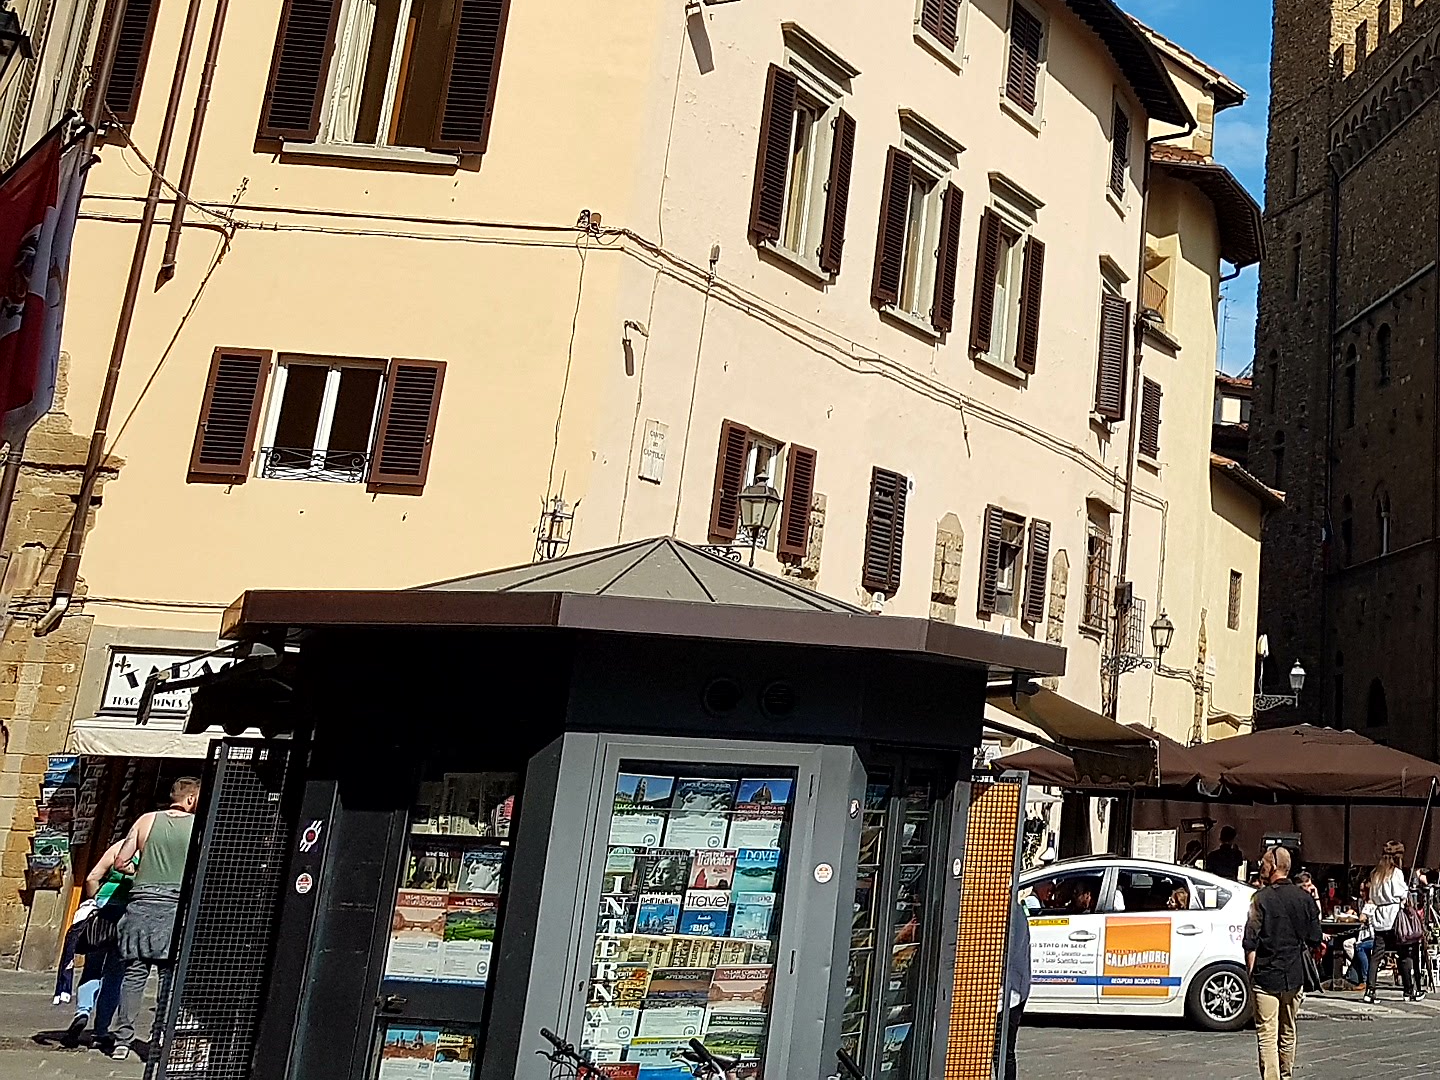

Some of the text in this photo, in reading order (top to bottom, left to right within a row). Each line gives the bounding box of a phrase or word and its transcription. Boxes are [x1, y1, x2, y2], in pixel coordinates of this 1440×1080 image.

[745, 850, 777, 862] DOVE
[687, 892, 729, 908] travel
[1104, 950, 1170, 968] CALAMANDREI
